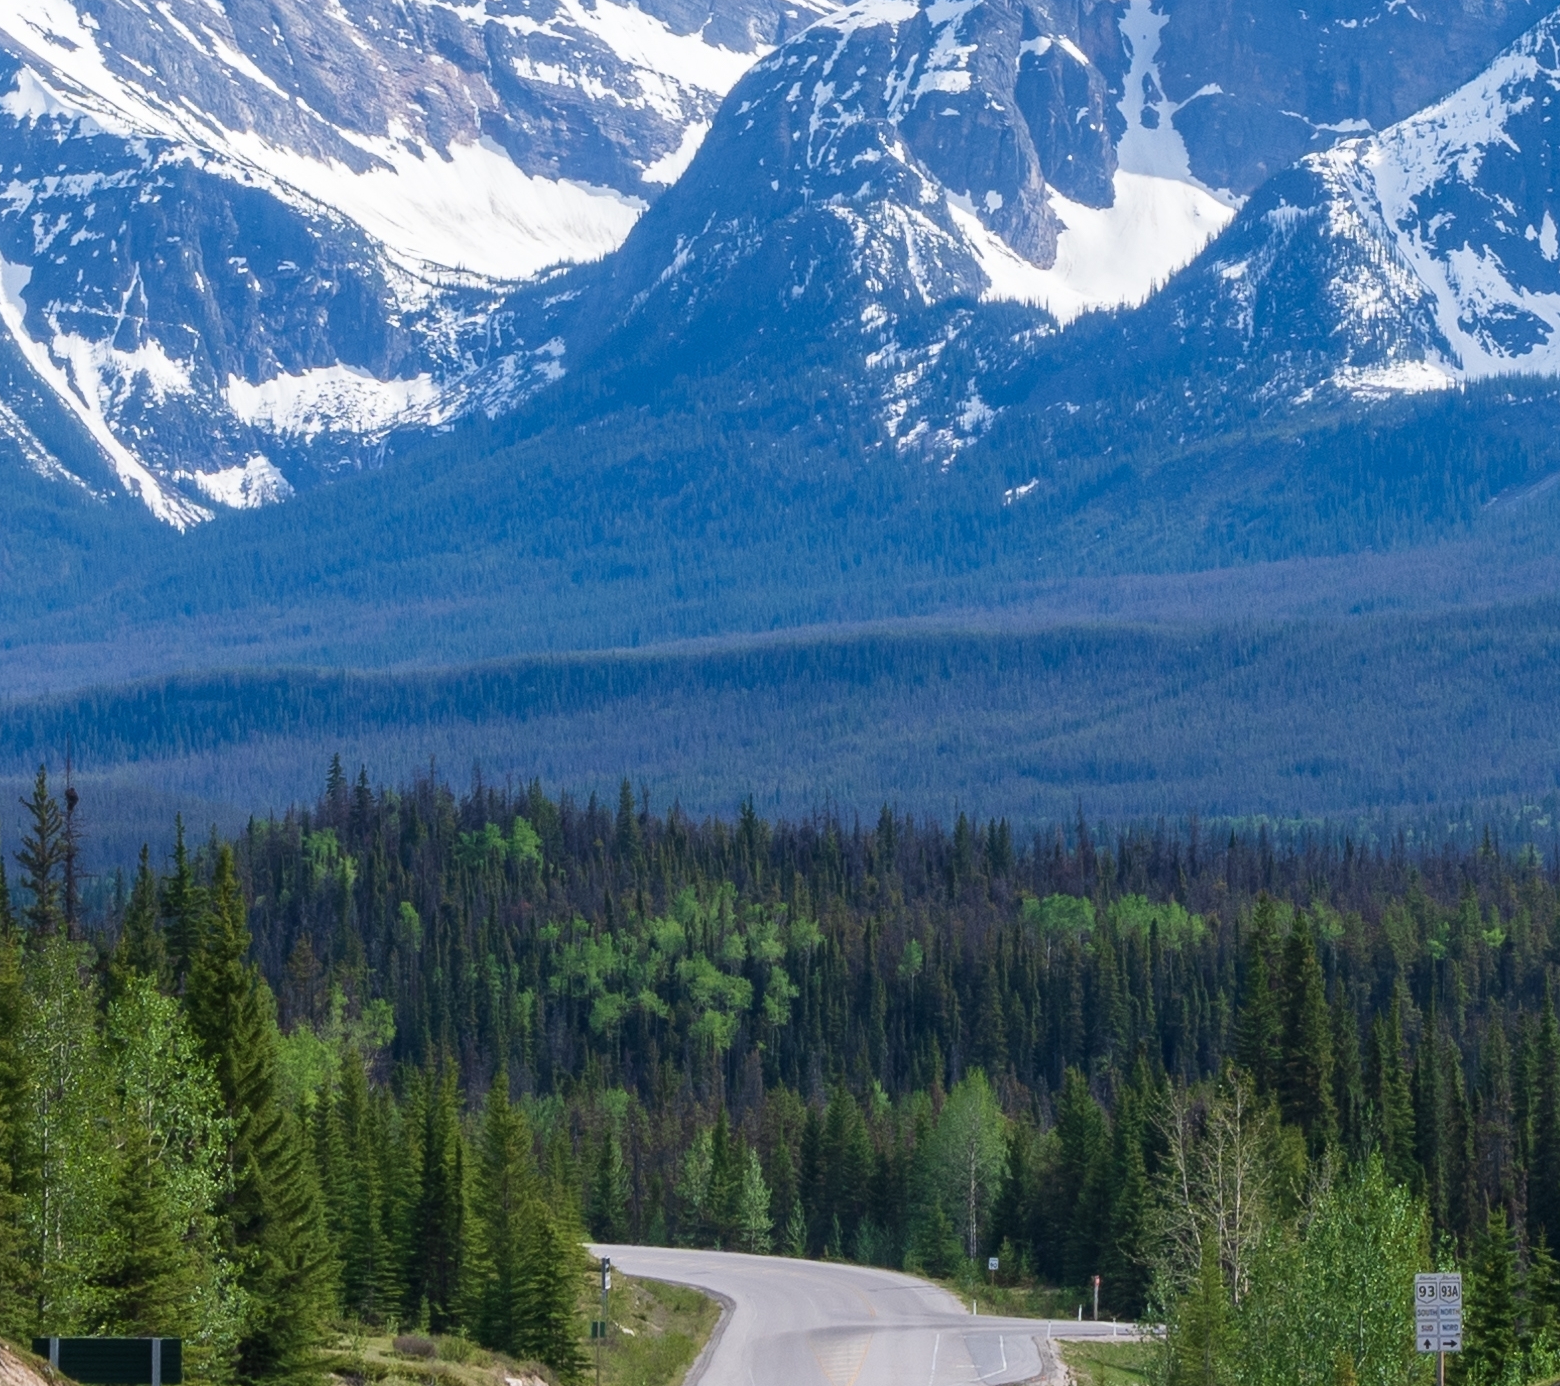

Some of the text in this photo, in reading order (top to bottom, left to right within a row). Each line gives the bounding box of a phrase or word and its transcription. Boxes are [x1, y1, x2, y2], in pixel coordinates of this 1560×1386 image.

[1419, 1286, 1435, 1297] 93
[1441, 1286, 1458, 1297] 93A
[1421, 1324, 1433, 1332] SUD
